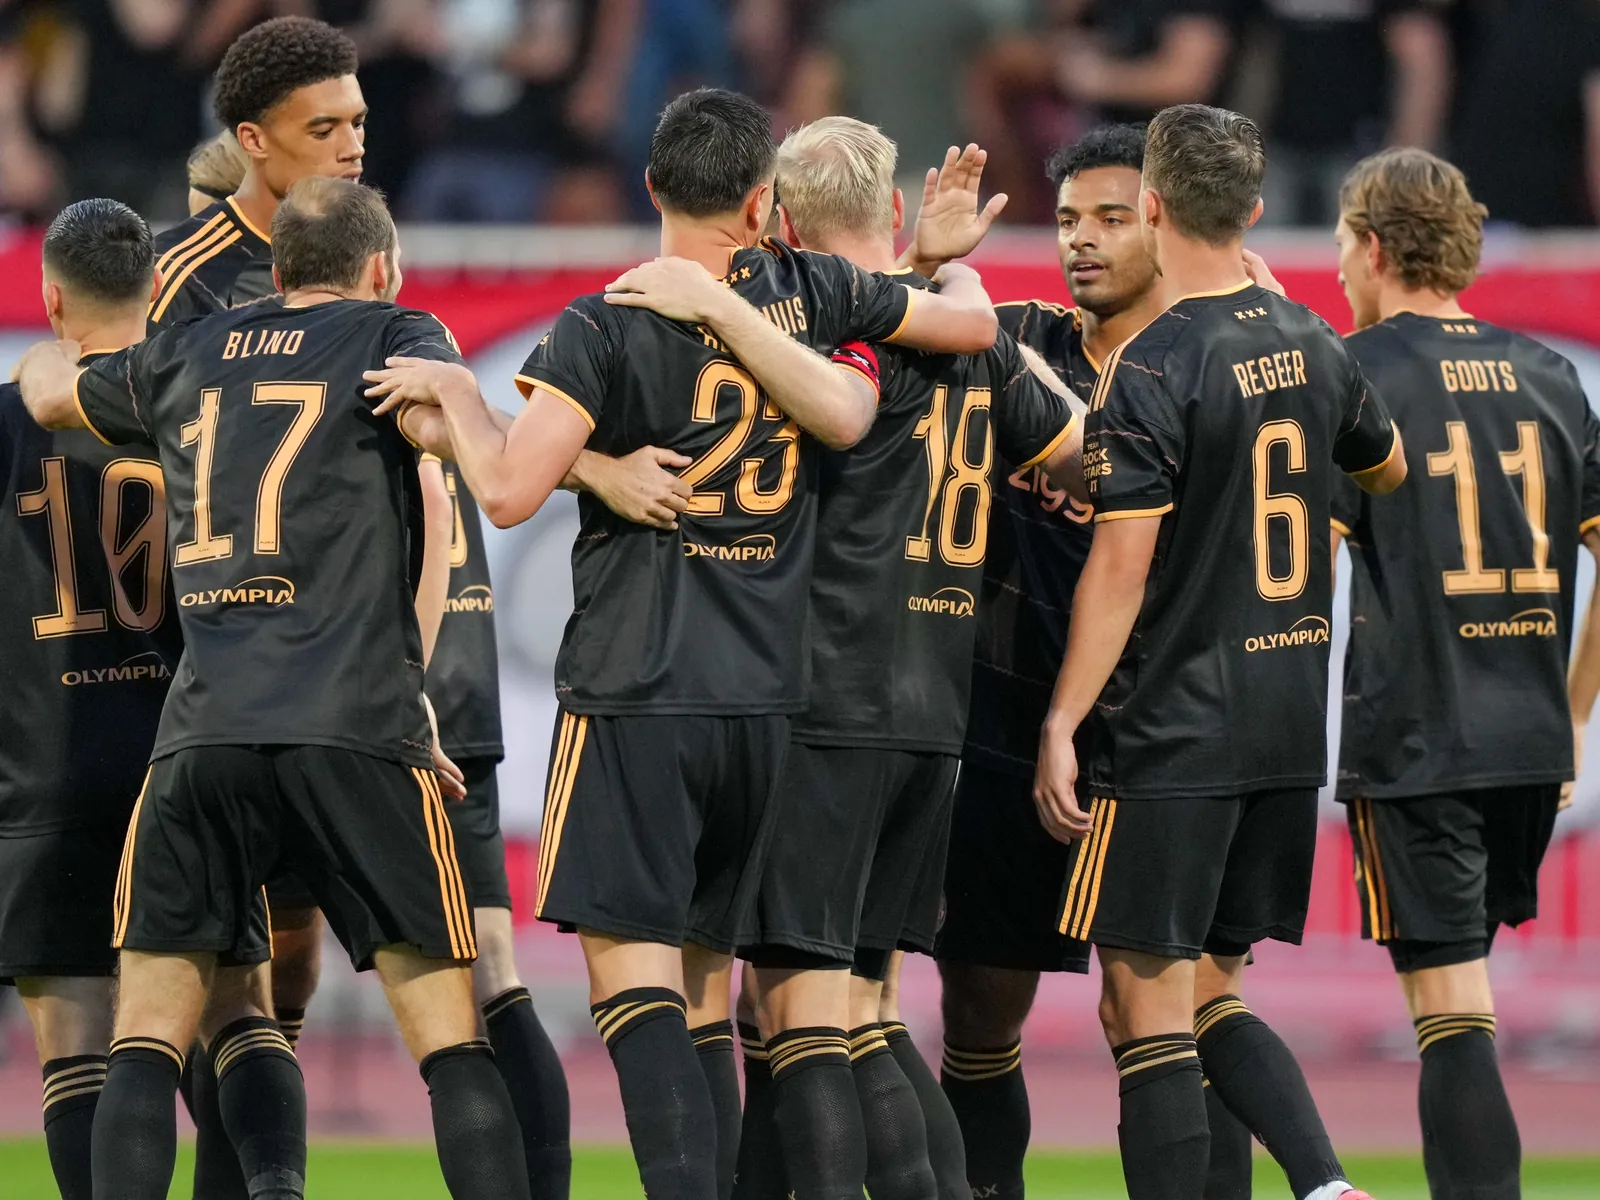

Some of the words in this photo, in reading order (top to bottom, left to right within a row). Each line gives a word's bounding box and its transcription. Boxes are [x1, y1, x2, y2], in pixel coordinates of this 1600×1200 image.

[222, 329, 305, 360] BLIND
[1232, 350, 1307, 399] REGEER
[1440, 359, 1518, 393] GODTS
[678, 359, 800, 516] 23
[1083, 447, 1109, 467] ROCK
[1083, 462, 1112, 481] STARS
[174, 380, 328, 568] 17
[904, 384, 992, 568] 18
[1252, 418, 1310, 602] 6
[1427, 420, 1560, 596] 11
[15, 456, 169, 641] 10
[682, 539, 776, 562] OLYMPIA
[180, 584, 295, 607] OLYMPIA
[444, 593, 494, 613] YMPIA
[1244, 624, 1329, 652] OLYMPIA
[1459, 617, 1557, 638] OLYMPIA
[61, 660, 173, 686] OLYMPIA
